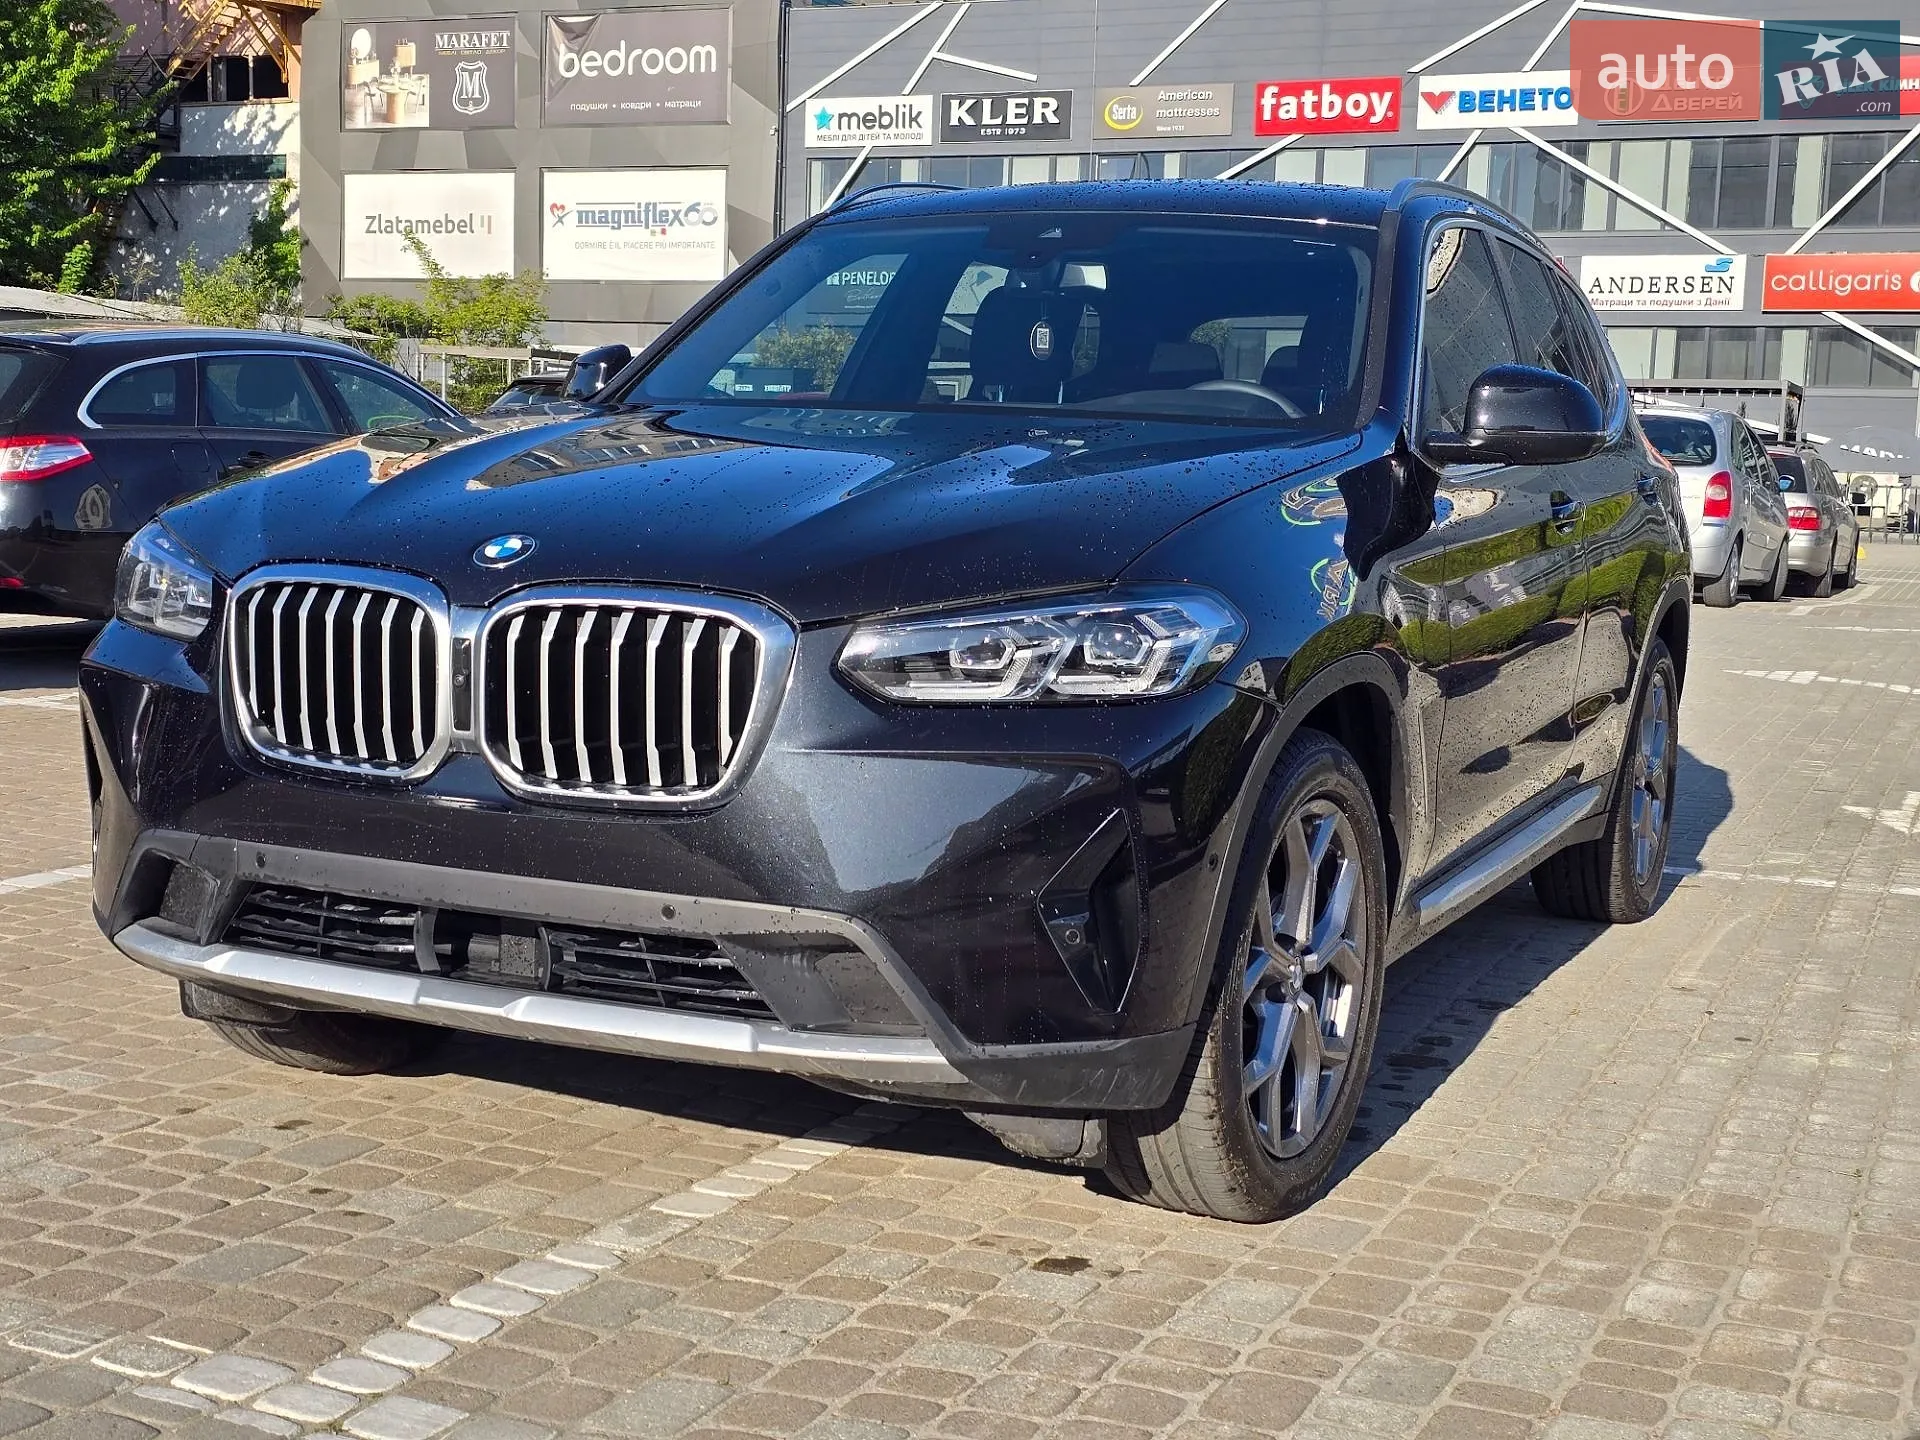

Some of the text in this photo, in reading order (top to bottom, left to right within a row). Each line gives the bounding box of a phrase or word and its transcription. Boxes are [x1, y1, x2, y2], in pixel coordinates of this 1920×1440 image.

[435, 32, 511, 49] MARAFET
[559, 40, 717, 78] bedroom
[1158, 90, 1214, 102] American
[1458, 87, 1574, 113] ВЕНЕТО
[570, 100, 702, 112] подушки ковдри матраци
[949, 97, 1061, 126] KLER
[1112, 104, 1138, 121] Serta
[1155, 106, 1221, 119] mattresses
[837, 104, 923, 131] meblik
[817, 132, 924, 142] МЕБЛІ ДЛЯ ДІТЕЙ ТА МОЛОДІ
[365, 213, 475, 234] Zlatamebel
[574, 241, 607, 250] DORMIRE
[623, 241, 653, 250] PIACERE
[668, 240, 715, 250] IMPORTANTE
[1589, 276, 1735, 294] ANDERSEN
[1771, 269, 1903, 296] calligaris
[1591, 298, 1634, 308] Матраци
[1636, 299, 1647, 307] та
[1650, 299, 1694, 308] подушки
[1704, 297, 1731, 307] Данії
